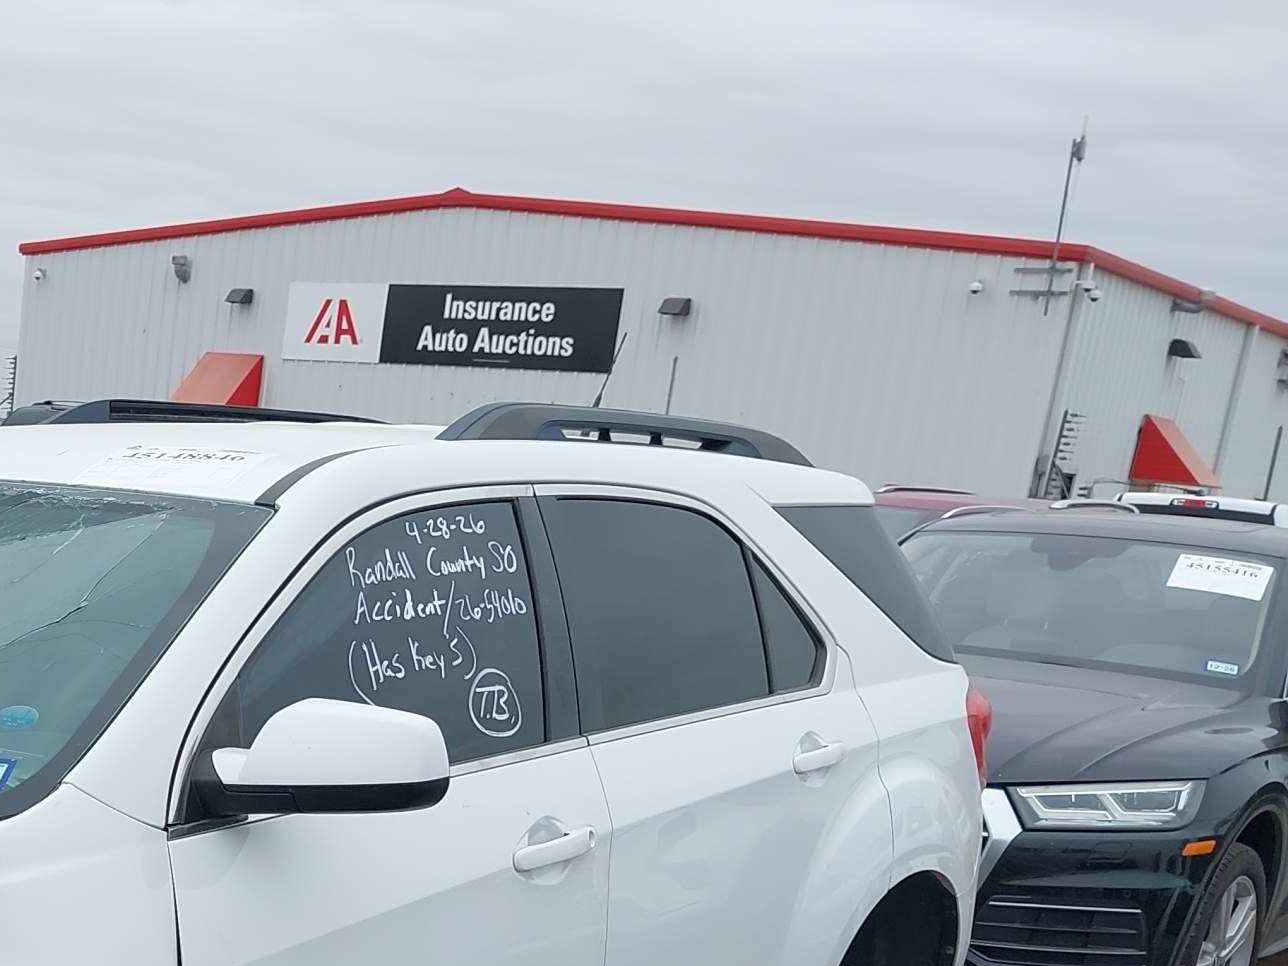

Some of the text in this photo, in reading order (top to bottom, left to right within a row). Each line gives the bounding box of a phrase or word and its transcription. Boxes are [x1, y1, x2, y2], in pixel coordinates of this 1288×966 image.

[443, 293, 555, 322] Insurance
[416, 325, 575, 357] Auto Auctions
[405, 512, 486, 544] 4-28-26
[346, 541, 518, 588] Randall County SO
